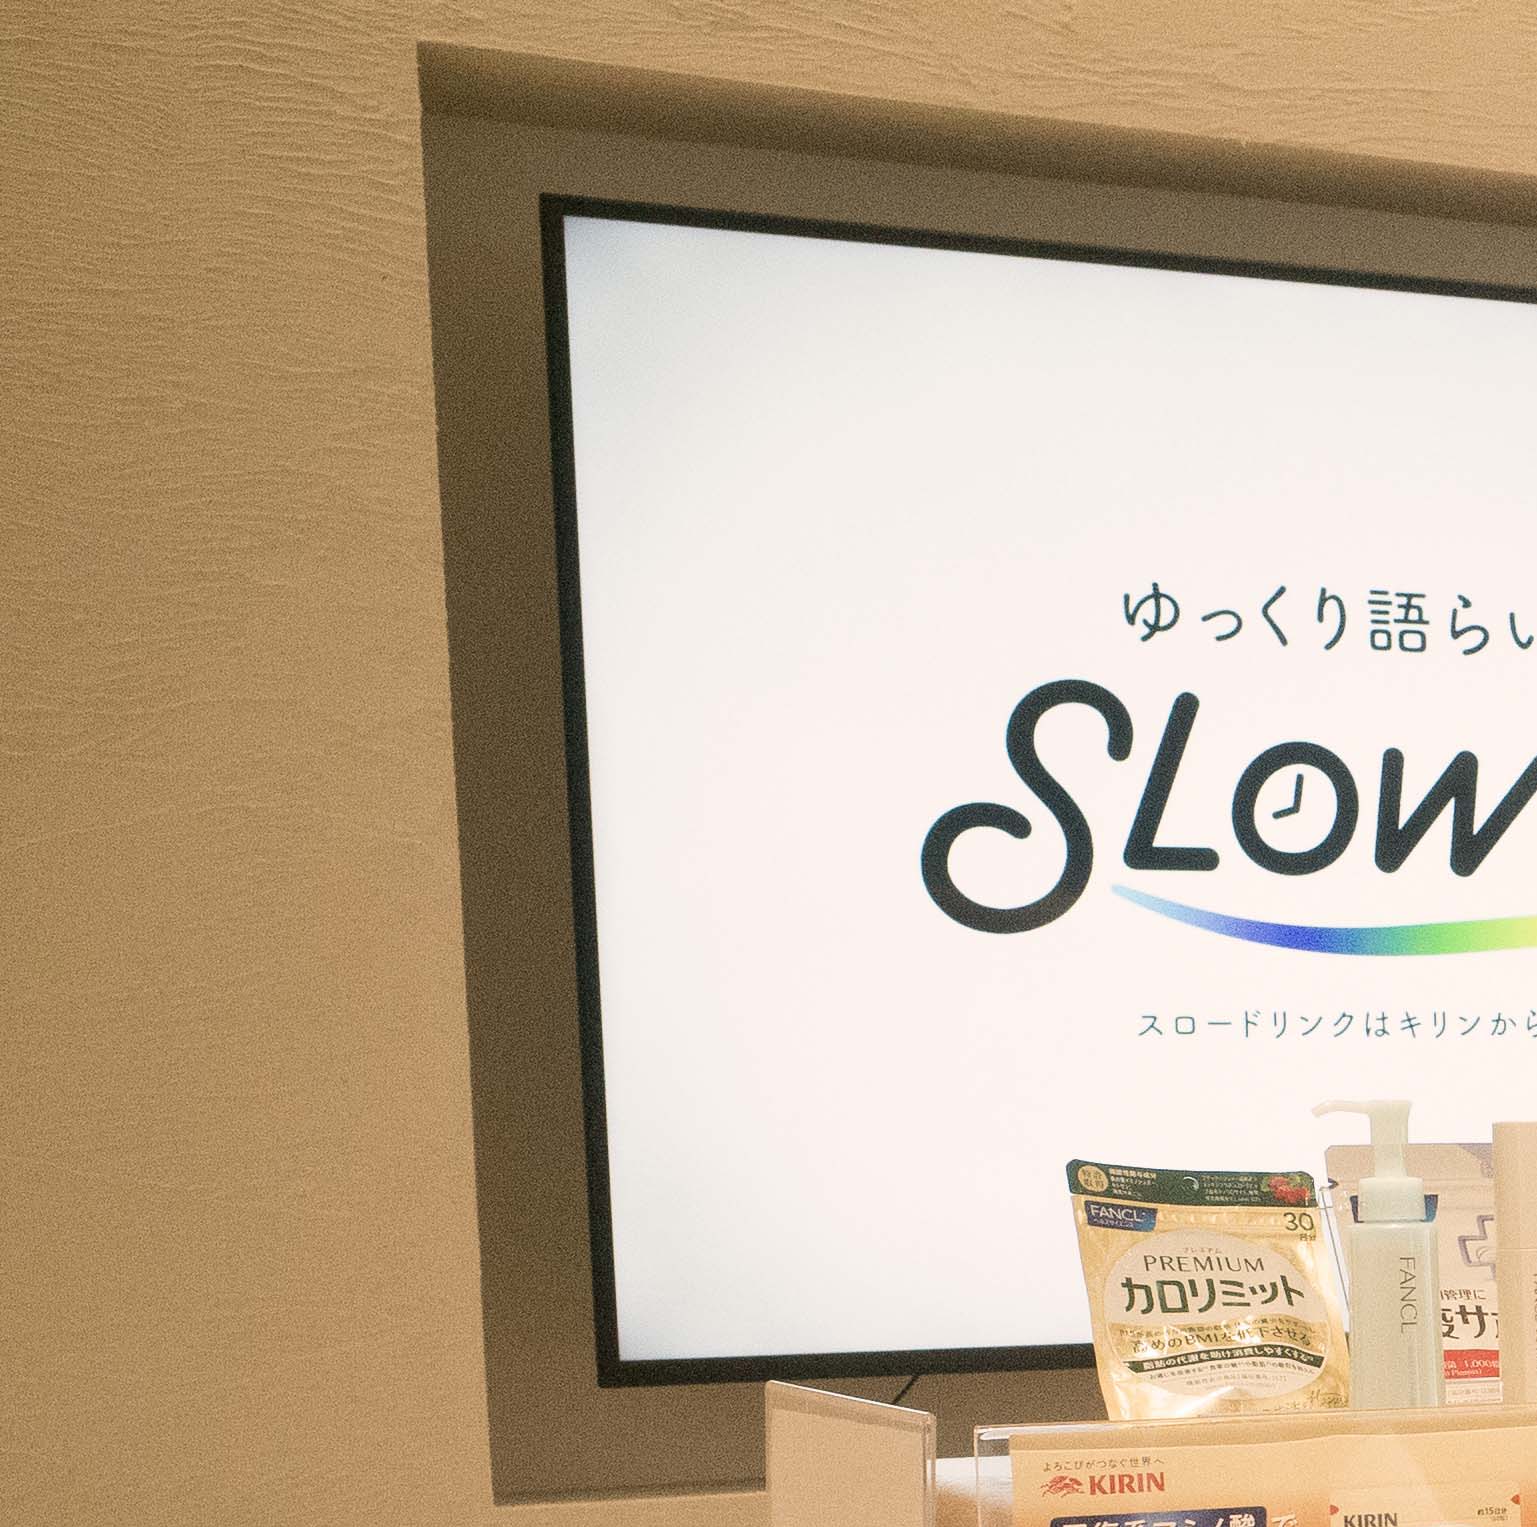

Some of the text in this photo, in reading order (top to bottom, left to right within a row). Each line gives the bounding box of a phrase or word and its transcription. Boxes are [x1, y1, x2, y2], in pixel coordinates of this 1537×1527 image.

[1090, 1205, 1145, 1222] FANCL
[1282, 1211, 1315, 1232] 30
[1143, 1254, 1265, 1273] PREMIUM
[1120, 1274, 1305, 1315] カロリミット
[1399, 1256, 1419, 1335] FANCL
[1043, 1455, 1166, 1473] よろこびがつなぐ世界へ
[1088, 1471, 1166, 1496] KIRIN
